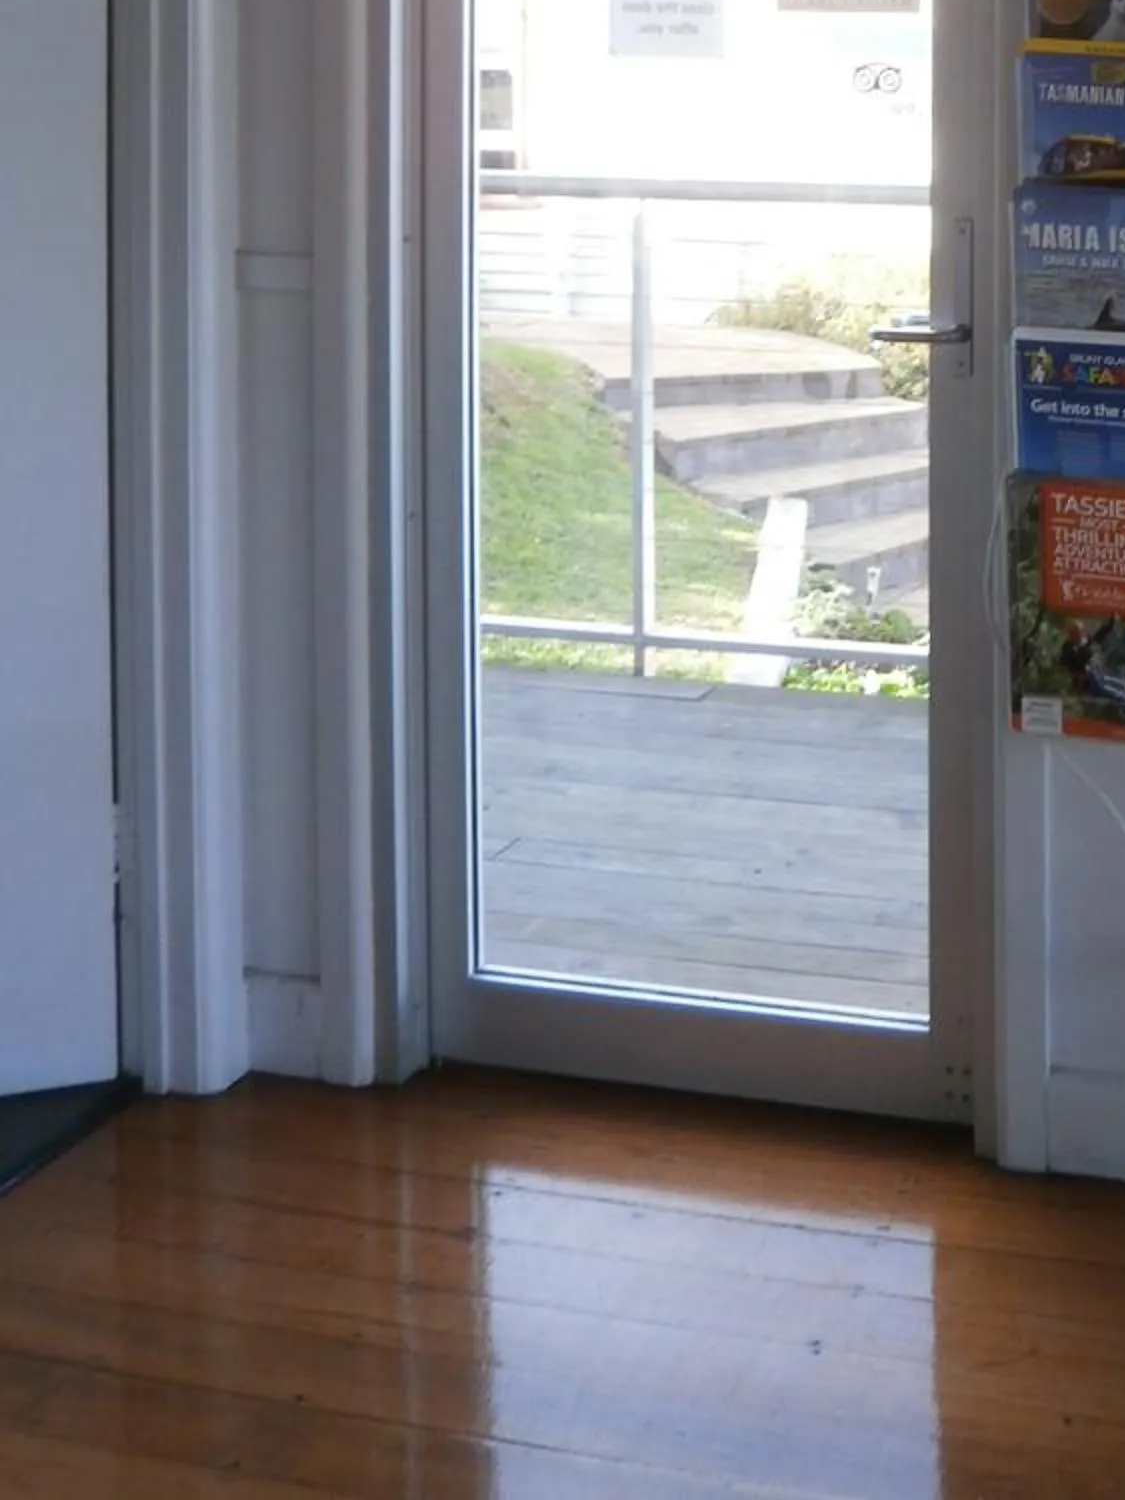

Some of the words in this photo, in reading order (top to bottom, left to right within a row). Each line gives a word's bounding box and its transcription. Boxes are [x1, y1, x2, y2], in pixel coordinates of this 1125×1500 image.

[1038, 82, 1125, 106] TASMANIAN
[1023, 222, 1101, 252] MARIA
[1069, 353, 1101, 365] BRUNY
[1030, 398, 1058, 415] Get
[1060, 400, 1091, 417] into
[1094, 402, 1120, 418] the
[1080, 515, 1119, 532] MOST
